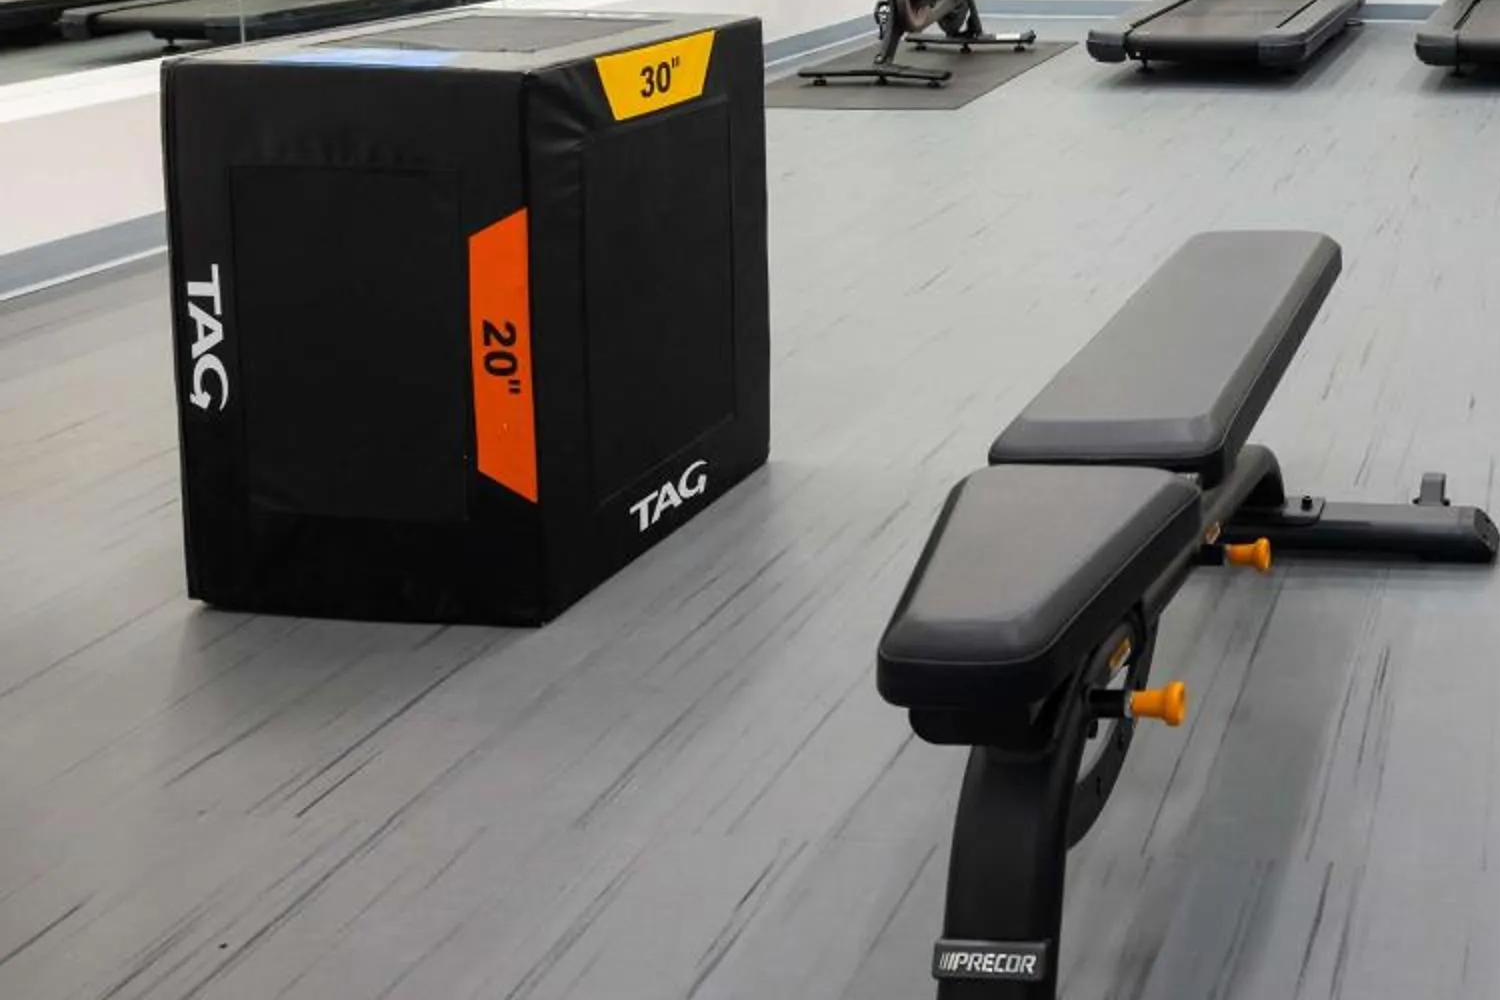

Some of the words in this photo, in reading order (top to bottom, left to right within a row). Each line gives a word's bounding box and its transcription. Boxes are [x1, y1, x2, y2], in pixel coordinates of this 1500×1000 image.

[186, 262, 230, 412] TAG
[628, 458, 709, 533] TAG
[953, 951, 1037, 975] PRECOR
